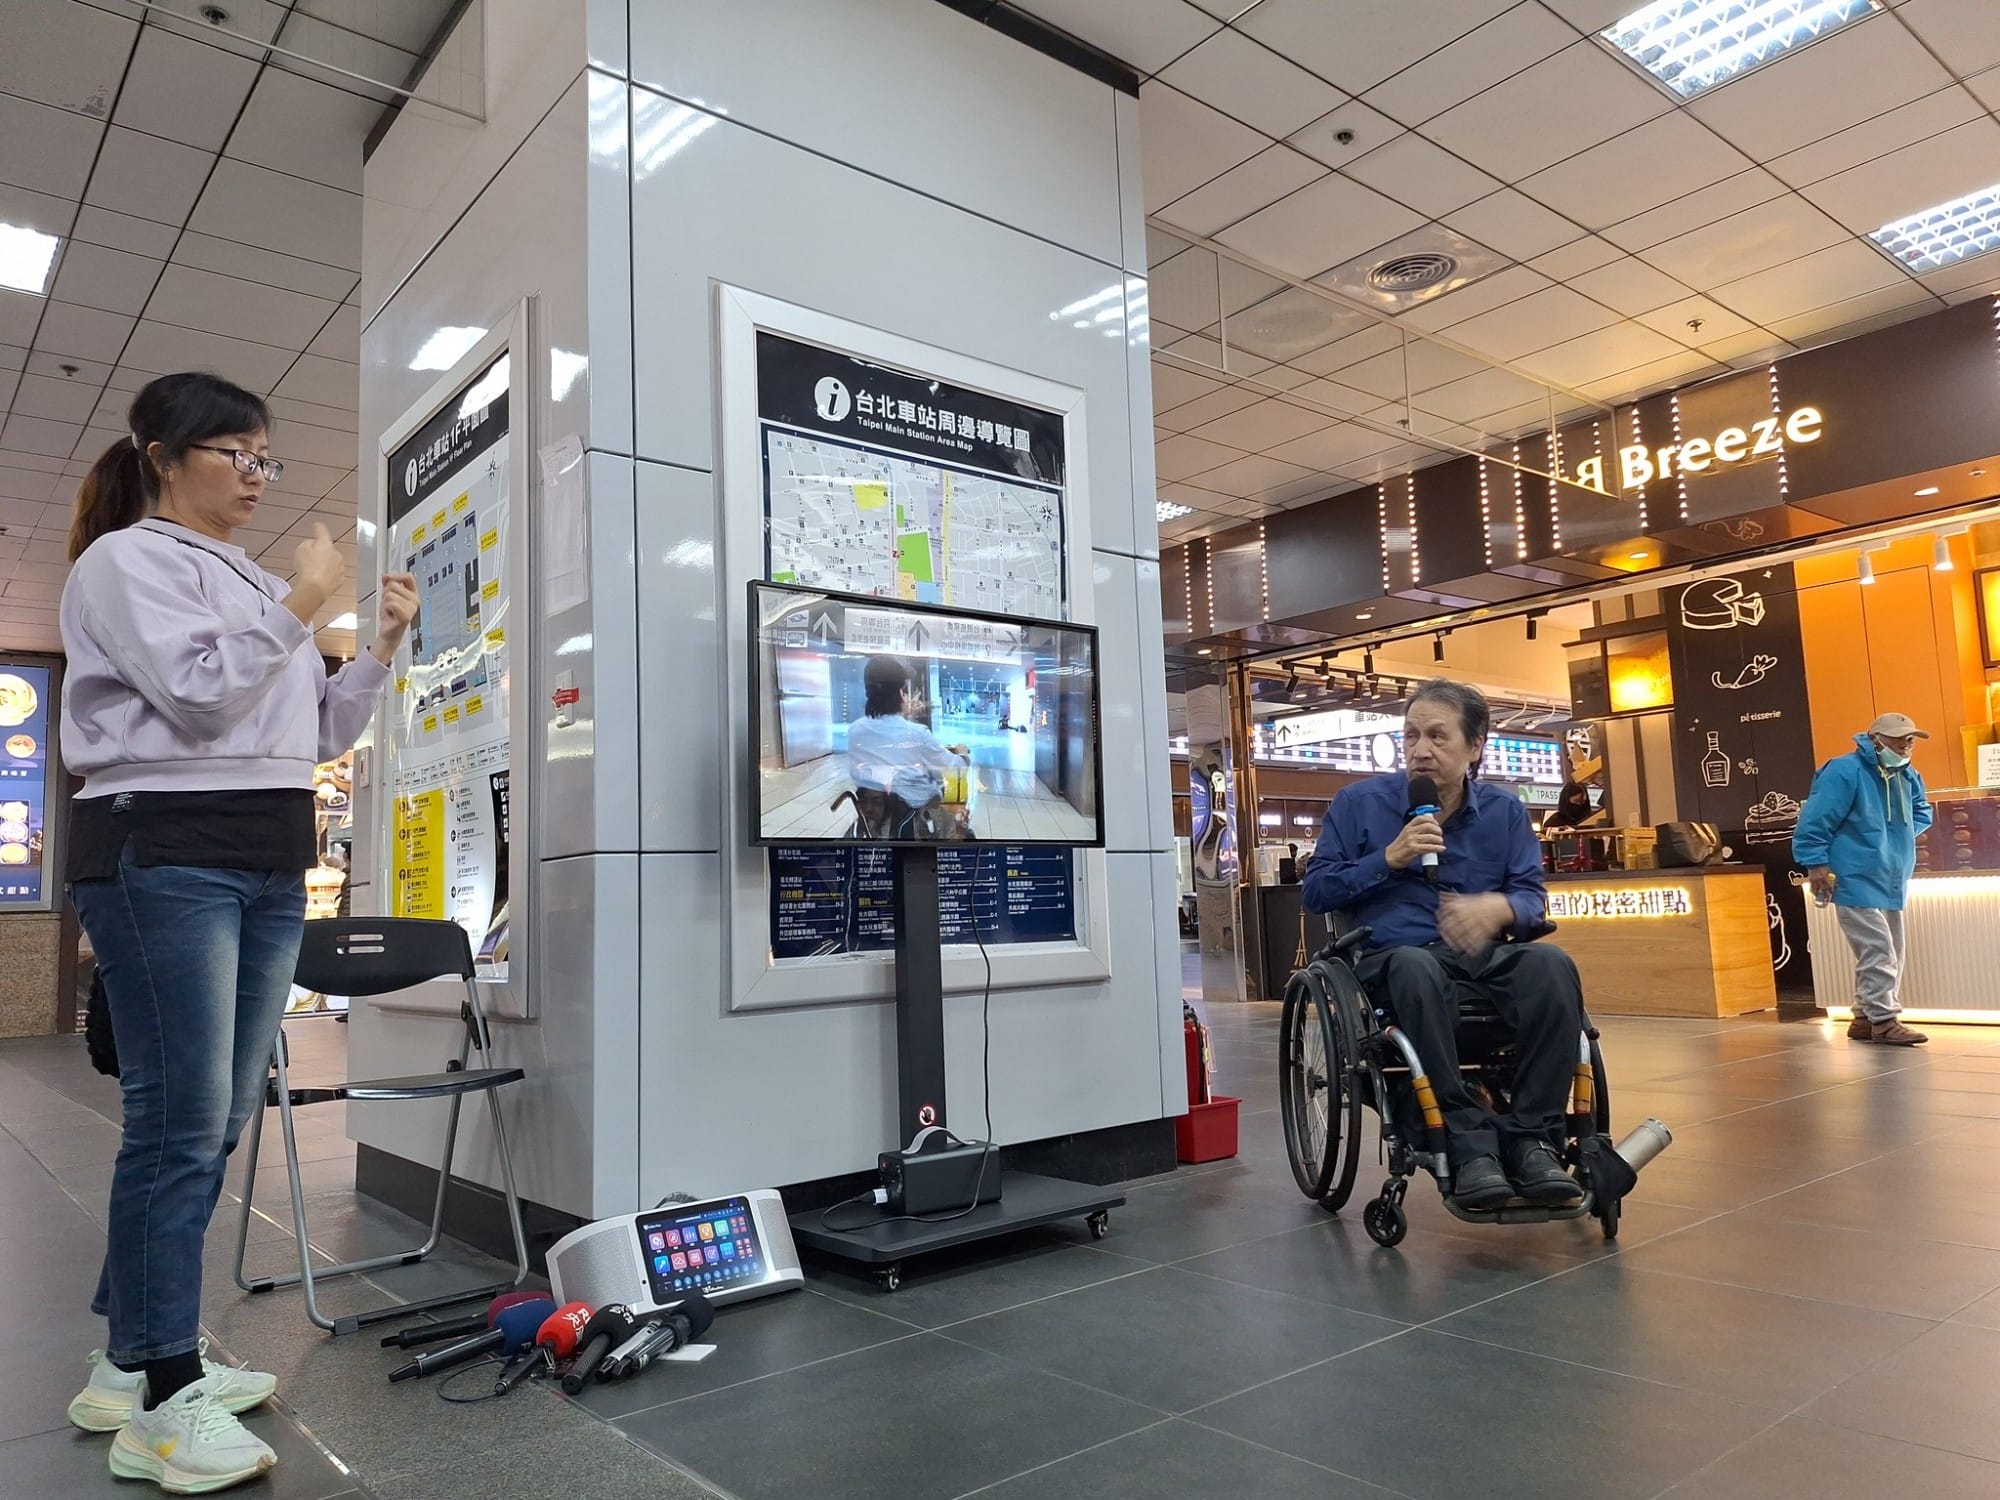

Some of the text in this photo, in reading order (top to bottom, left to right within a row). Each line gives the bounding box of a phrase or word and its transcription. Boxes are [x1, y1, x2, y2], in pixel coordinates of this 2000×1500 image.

[855, 389, 1031, 453] 台北車站周邊導覽圖
[857, 416, 974, 452] Taipei Main Station Area Map
[1619, 406, 1823, 489] Breeze
[1536, 790, 1559, 800] TPASS
